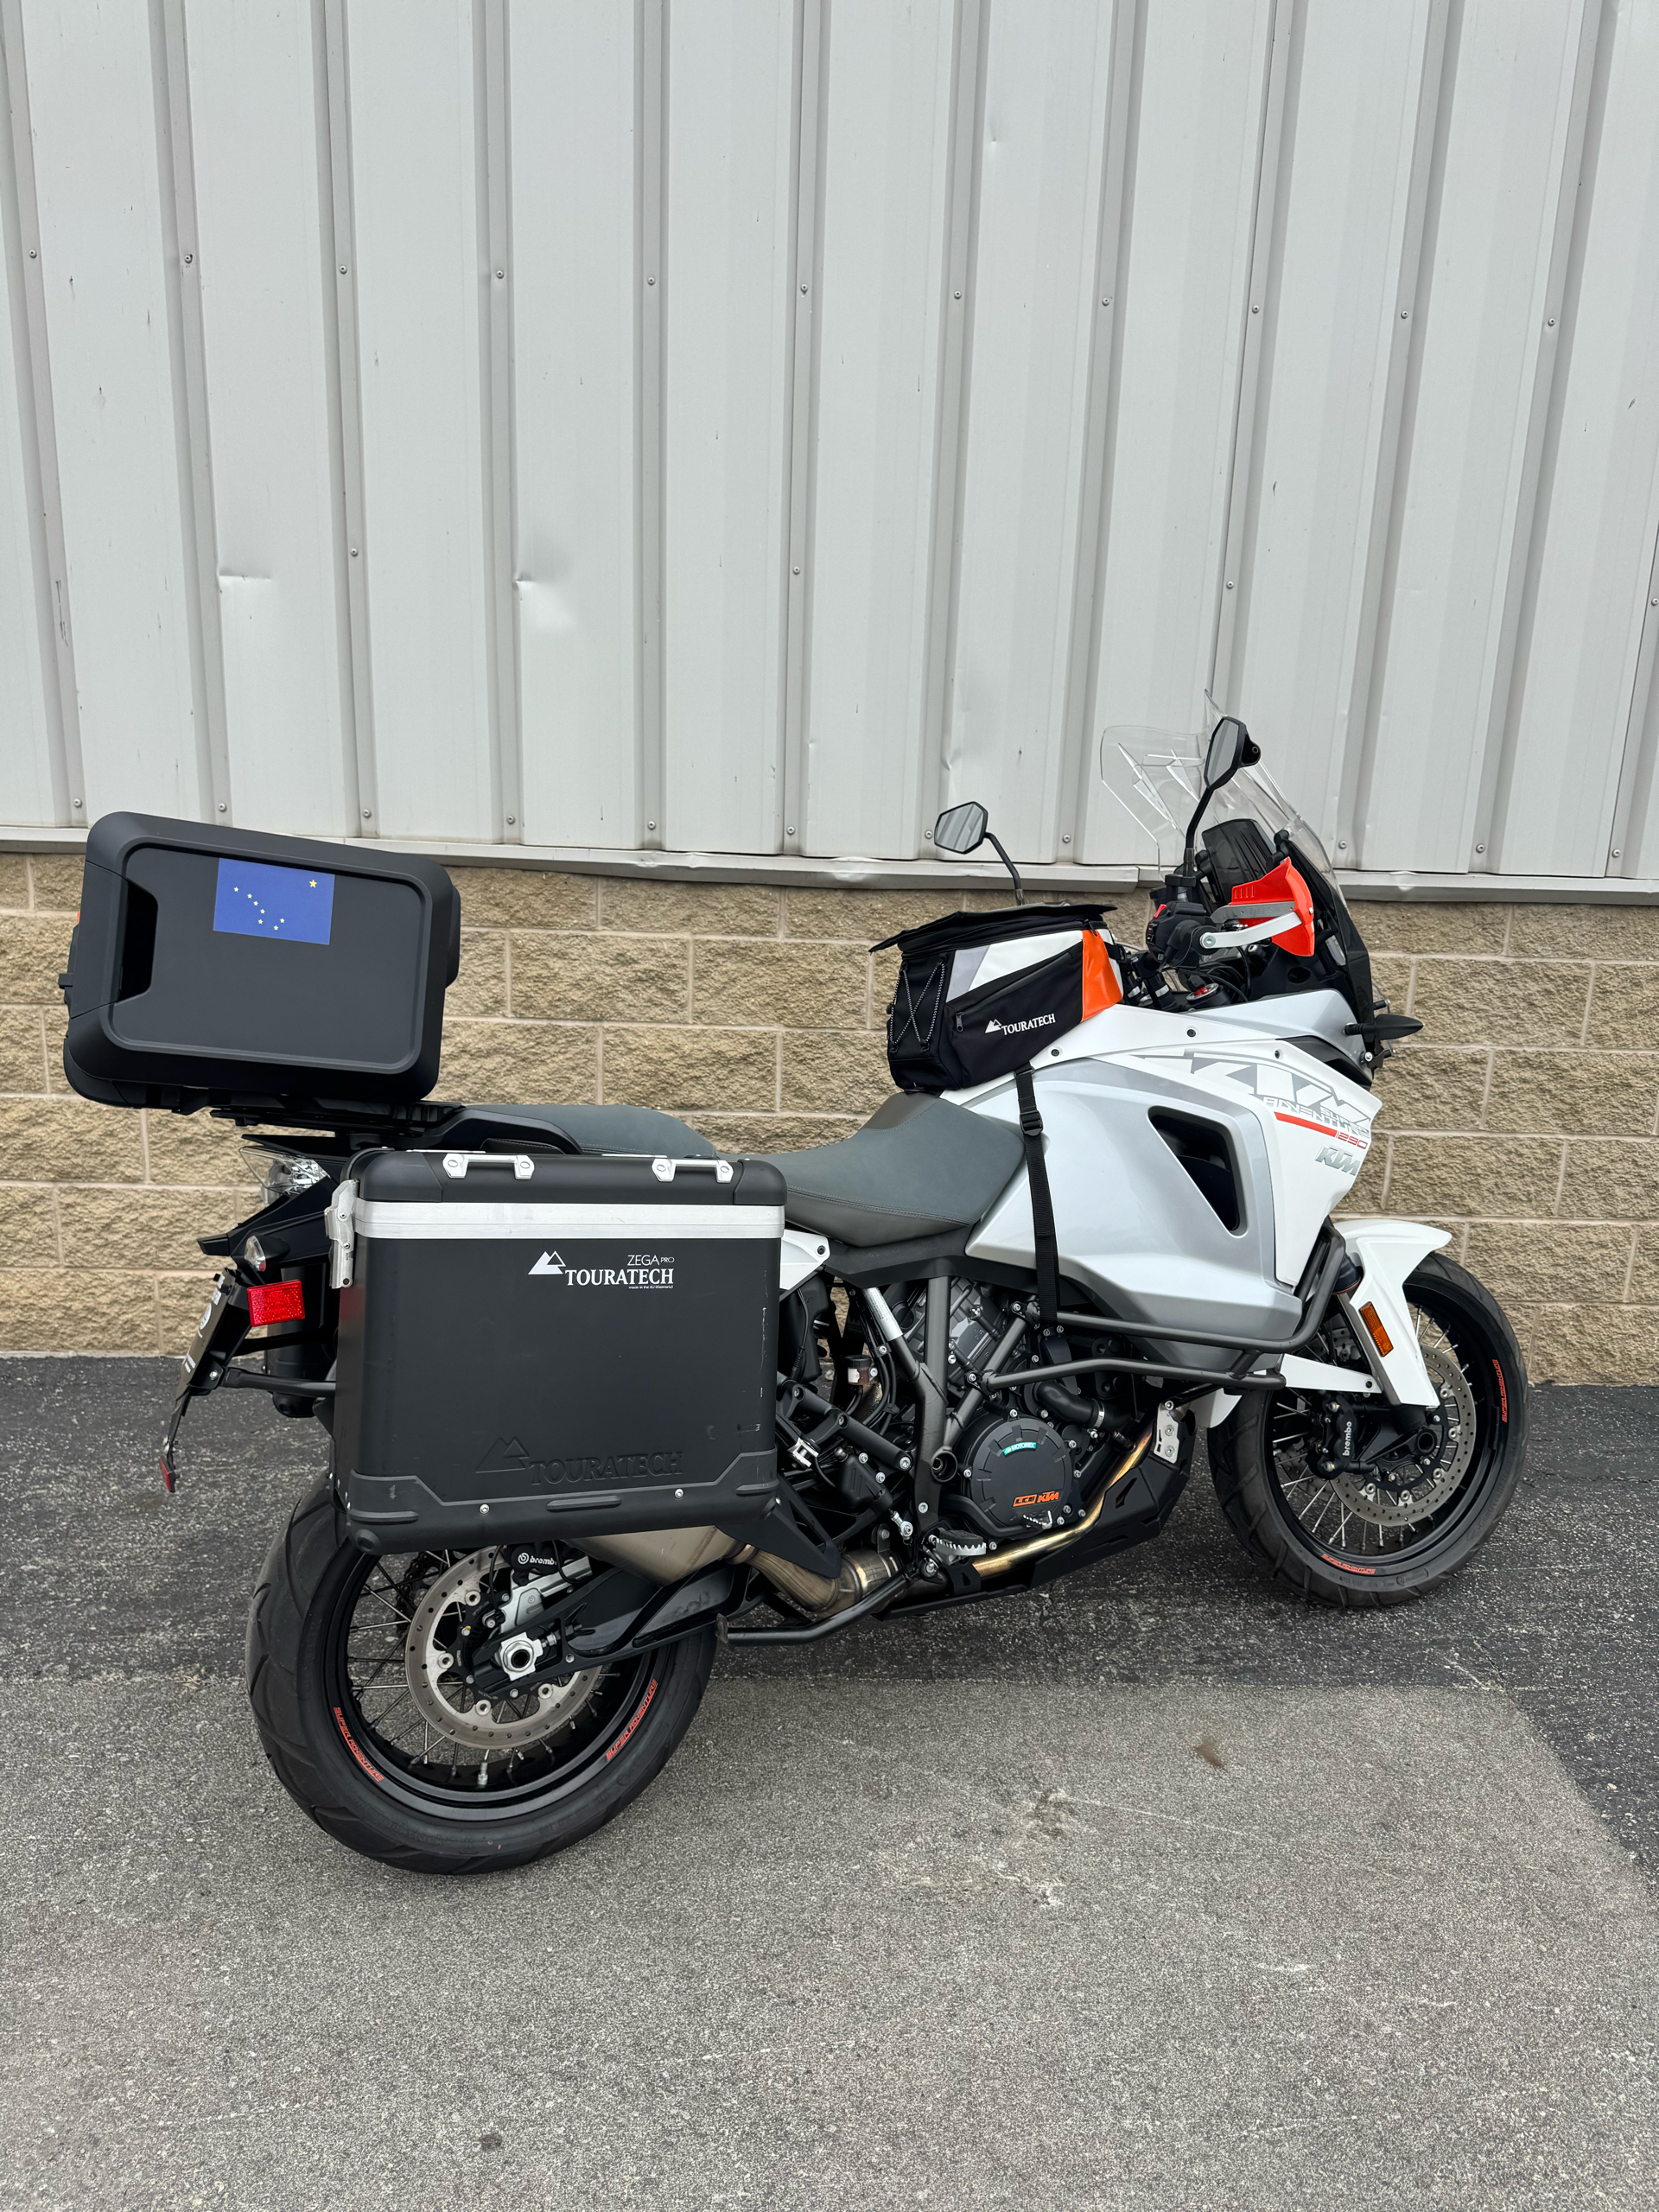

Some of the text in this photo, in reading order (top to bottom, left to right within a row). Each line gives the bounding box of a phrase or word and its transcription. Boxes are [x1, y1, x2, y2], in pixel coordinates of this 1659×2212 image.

[1001, 1013, 1056, 1036] TOURATECH
[1314, 1146, 1362, 1176] KTM
[627, 1255, 660, 1266] ZEGA
[565, 1268, 674, 1286] TOURATECH
[1011, 1442, 1035, 1452] MOTOREX
[1342, 1421, 1352, 1456] brembo
[529, 1452, 683, 1485] TOURATECH
[1037, 1491, 1059, 1503] KTM
[334, 1707, 385, 1783] SUPER ADVENTURE
